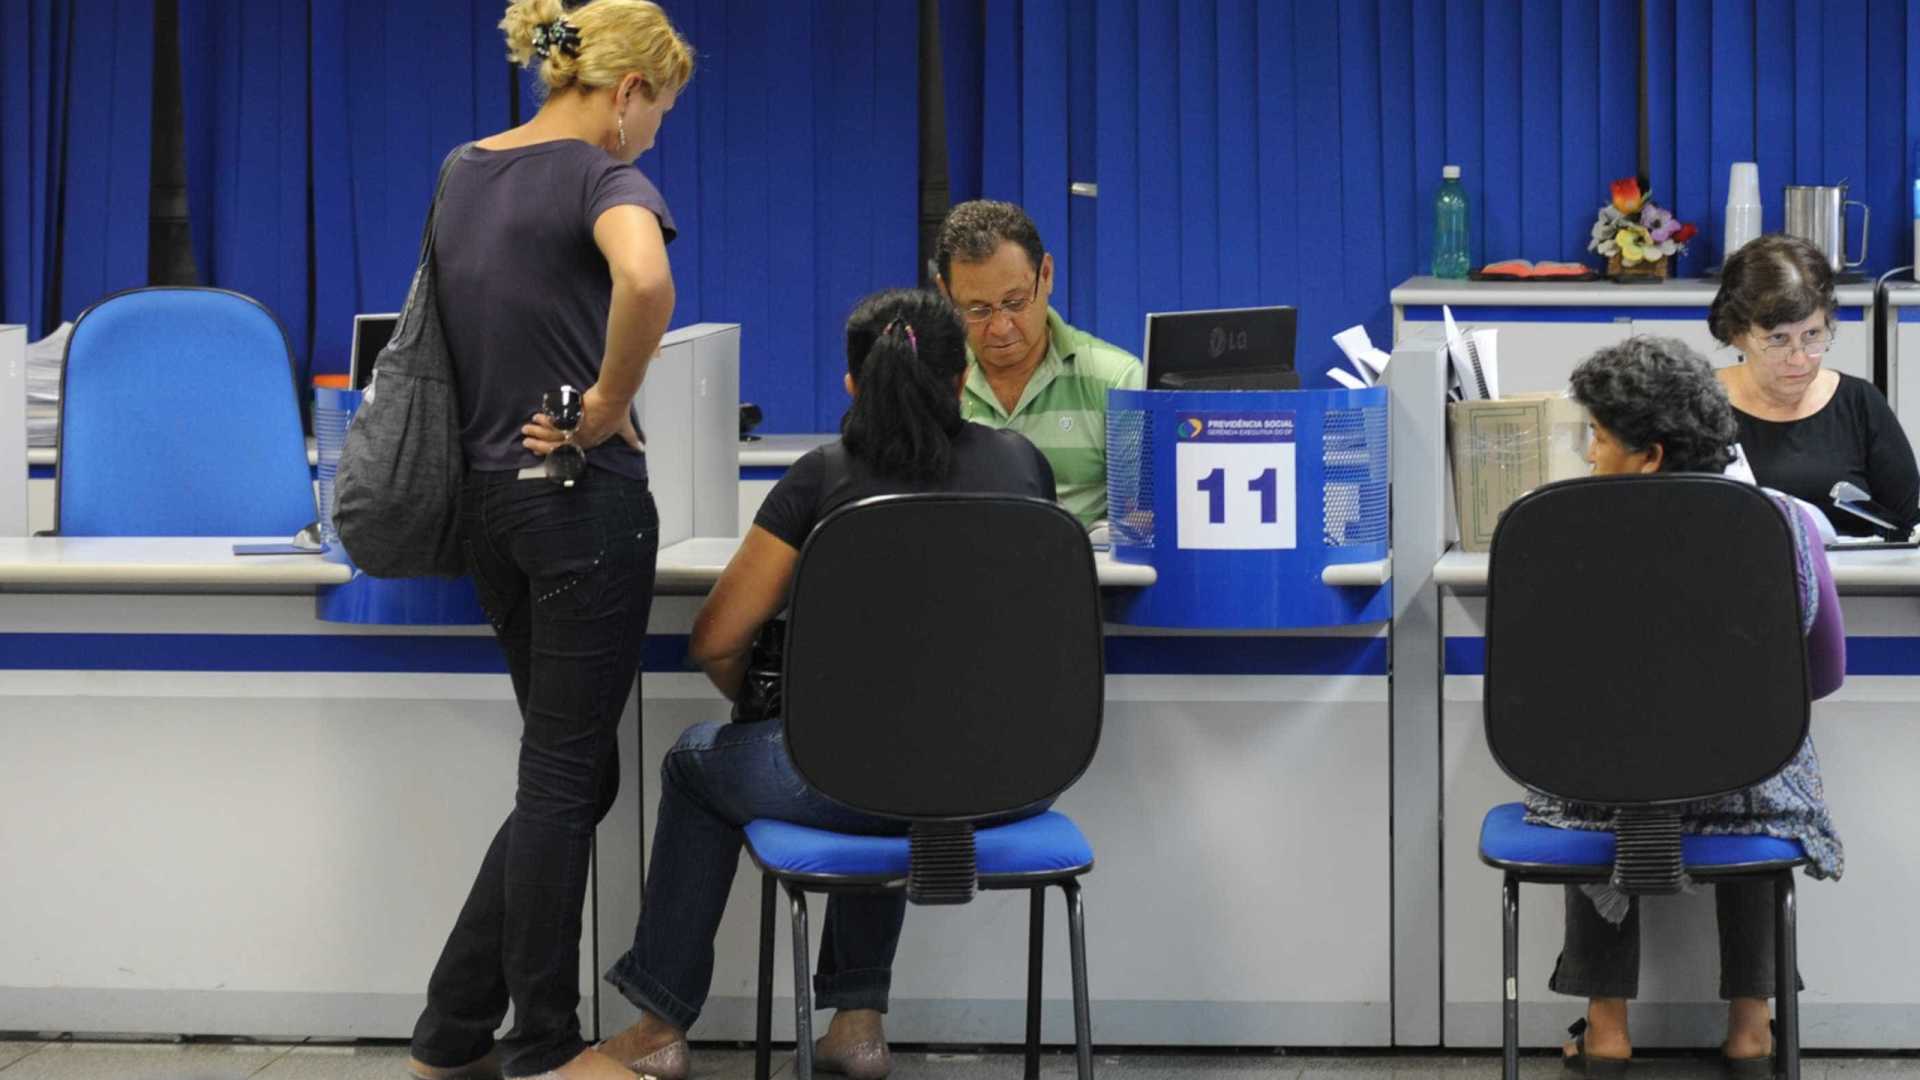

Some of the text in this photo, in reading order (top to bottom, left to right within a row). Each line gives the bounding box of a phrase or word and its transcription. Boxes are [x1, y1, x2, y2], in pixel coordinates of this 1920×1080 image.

[1208, 418, 1294, 428] PREVIDÊNCIA SOCIAL
[1197, 468, 1277, 523] 11
